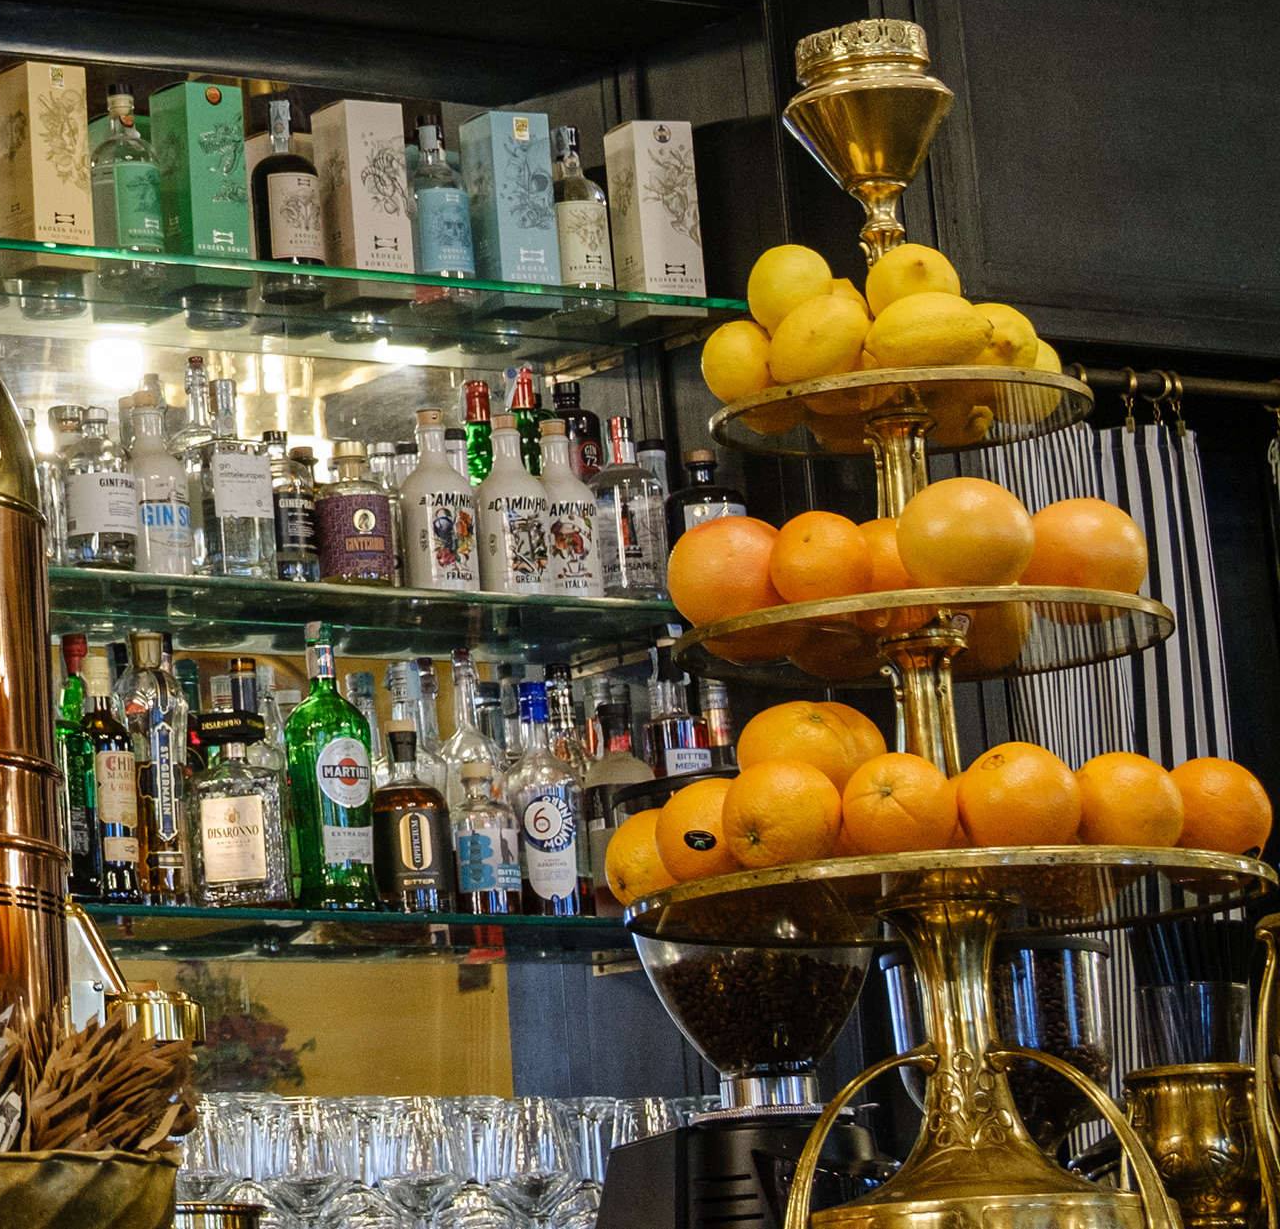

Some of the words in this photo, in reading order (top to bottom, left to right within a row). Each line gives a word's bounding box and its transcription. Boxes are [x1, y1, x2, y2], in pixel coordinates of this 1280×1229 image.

[38, 225, 66, 233] BROKEN
[68, 228, 91, 236] BONES
[197, 243, 225, 252] BROKEN
[227, 245, 249, 254] BONES
[370, 252, 402, 260] BROKEN
[364, 259, 391, 268] BONES
[395, 261, 409, 269] GIN
[516, 264, 549, 273] BROKEN
[510, 272, 537, 281] BONES
[541, 274, 555, 282] GIN
[649, 276, 675, 284] BROKEN
[678, 276, 703, 284] BONES
[583, 444, 597, 455] GIN
[585, 454, 599, 466] 72
[218, 462, 231, 471] gin
[99, 478, 136, 489] GINEPRA
[279, 498, 315, 510] GINEPRA
[141, 505, 172, 526] GIN
[676, 752, 708, 761] BITTER
[323, 765, 369, 780] MARTINI
[541, 795, 574, 849] MONTANARO
[207, 824, 259, 839] DISARONNO
[331, 830, 358, 838] EXTRA
[413, 819, 422, 864] OPIFICIUM
